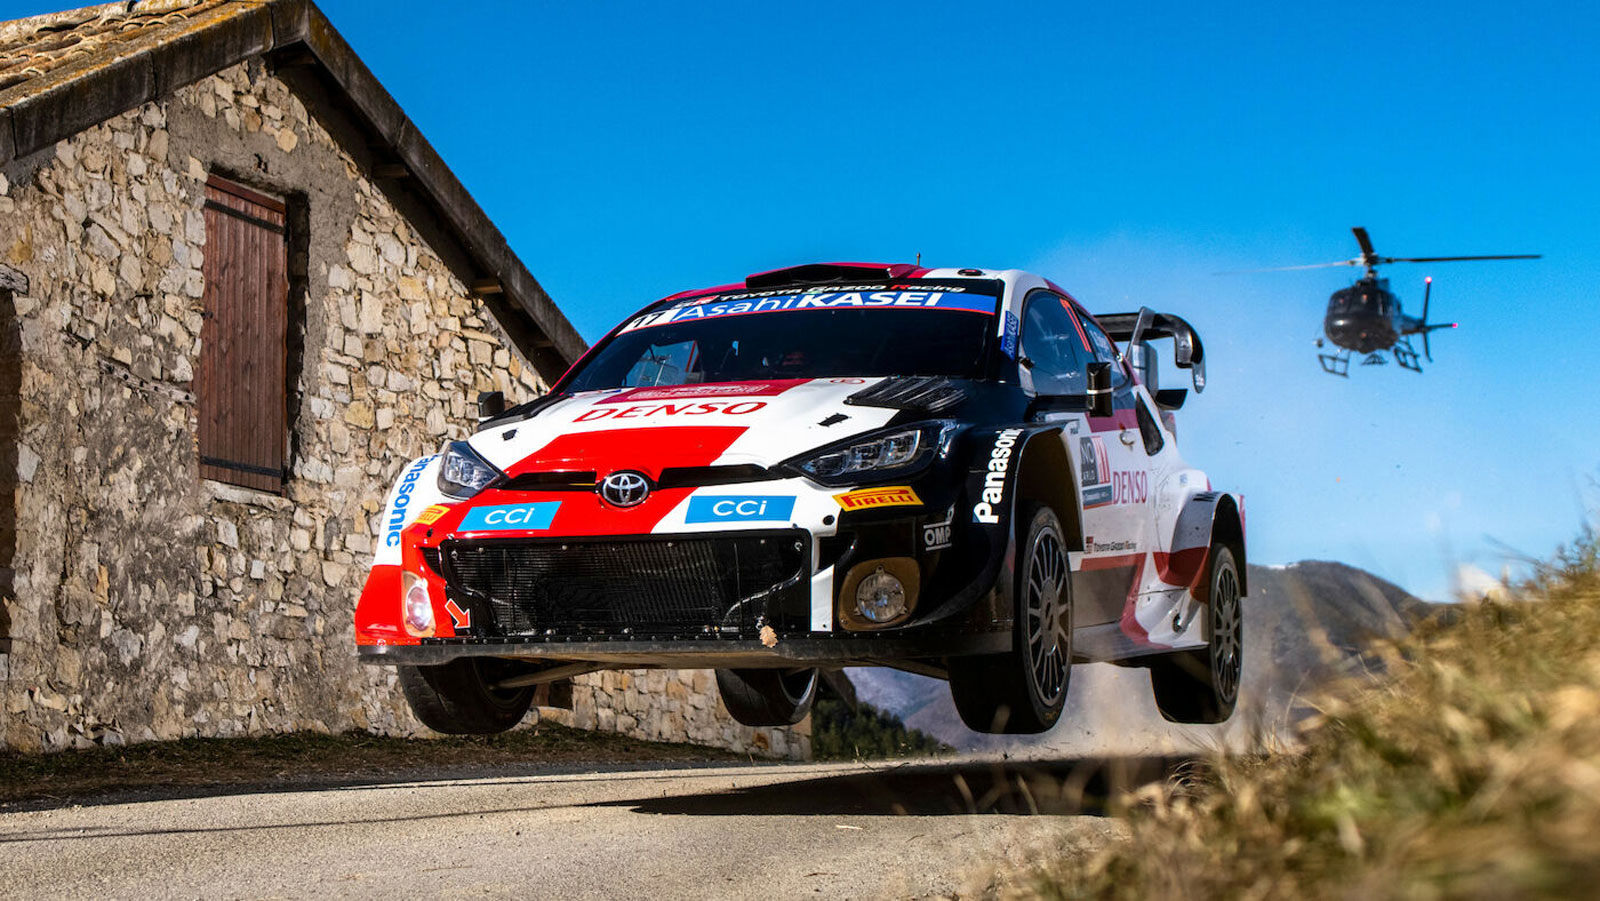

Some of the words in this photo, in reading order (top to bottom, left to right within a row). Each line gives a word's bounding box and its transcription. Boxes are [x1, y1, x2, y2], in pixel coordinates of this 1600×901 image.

[571, 402, 768, 423] DENSO
[973, 428, 1024, 524] Panasoni
[1113, 470, 1148, 505] DENSO
[840, 489, 914, 508] PIRELLI
[924, 525, 952, 546] OMP
